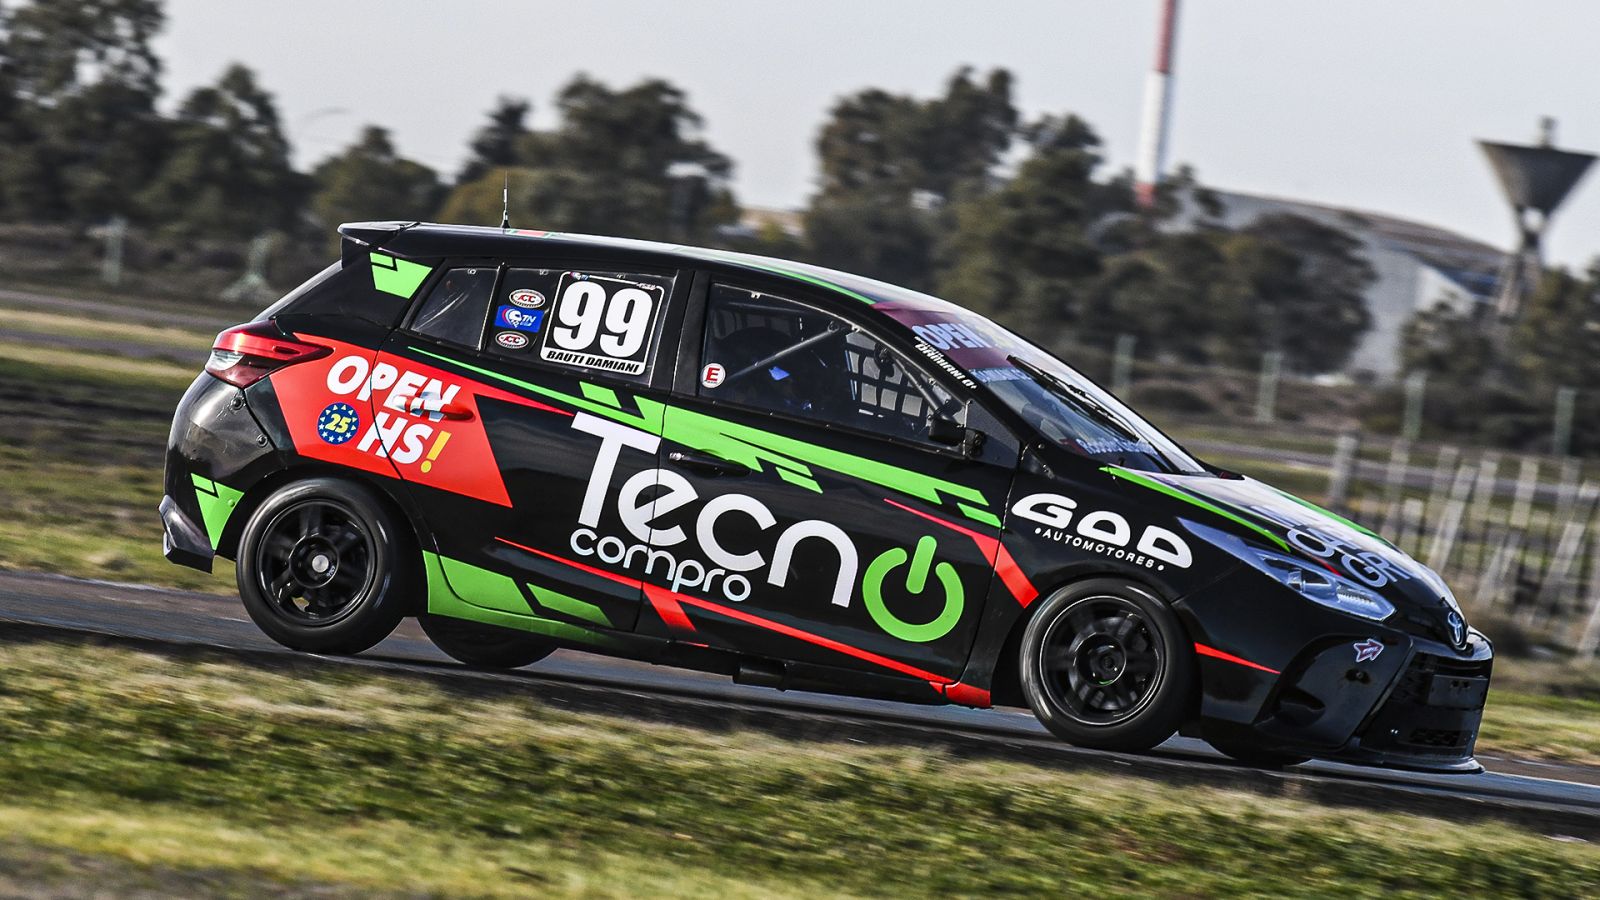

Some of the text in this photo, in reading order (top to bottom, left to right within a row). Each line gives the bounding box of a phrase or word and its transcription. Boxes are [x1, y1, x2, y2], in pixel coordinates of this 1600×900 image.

[553, 281, 653, 358] 99
[911, 323, 993, 350] OPEN
[546, 350, 640, 373] BAUTI DAMIANI
[706, 367, 721, 381] E
[327, 355, 461, 422] OPEN
[325, 413, 351, 434] 25
[356, 411, 452, 473] HS!
[570, 528, 751, 602] compro
[1042, 527, 1155, 569] AUTOMOTORES
